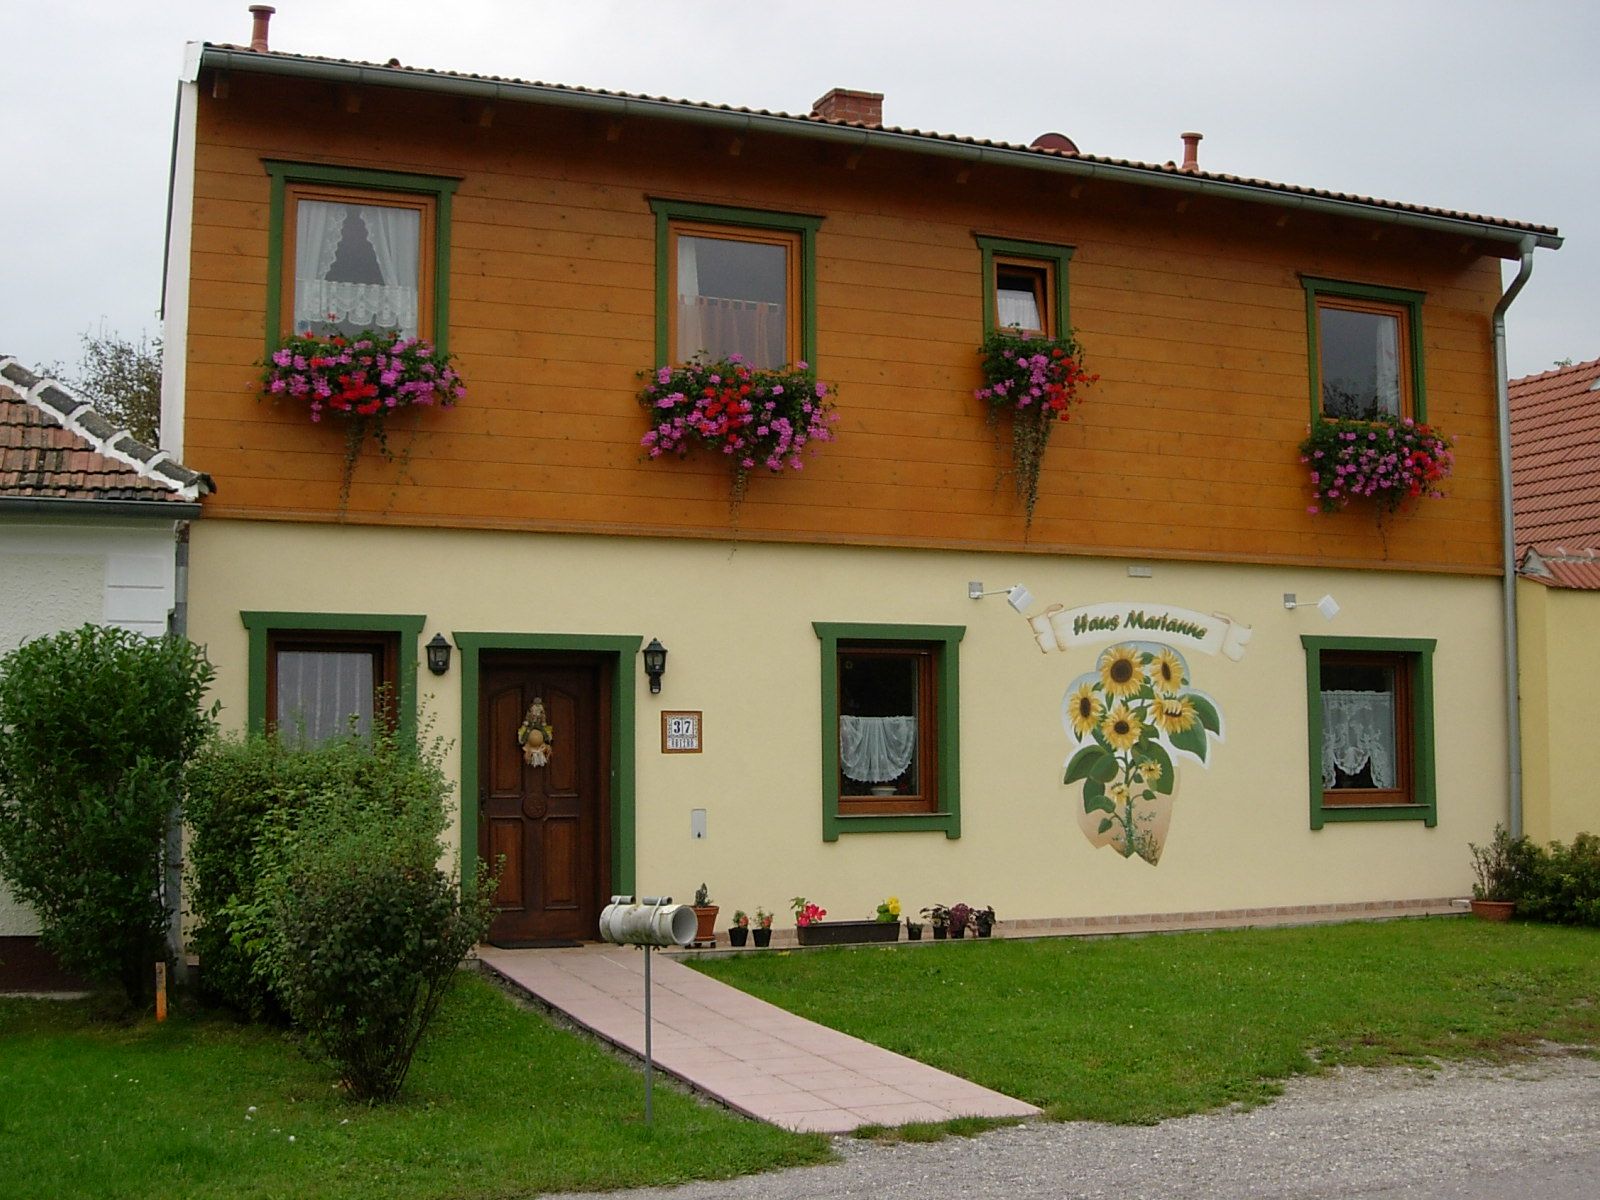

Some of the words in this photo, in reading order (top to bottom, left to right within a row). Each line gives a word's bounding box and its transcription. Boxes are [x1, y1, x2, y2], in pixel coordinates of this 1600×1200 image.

[1074, 613, 1120, 636] Haus
[1124, 610, 1208, 640] Marianne
[673, 720, 691, 734] 37
